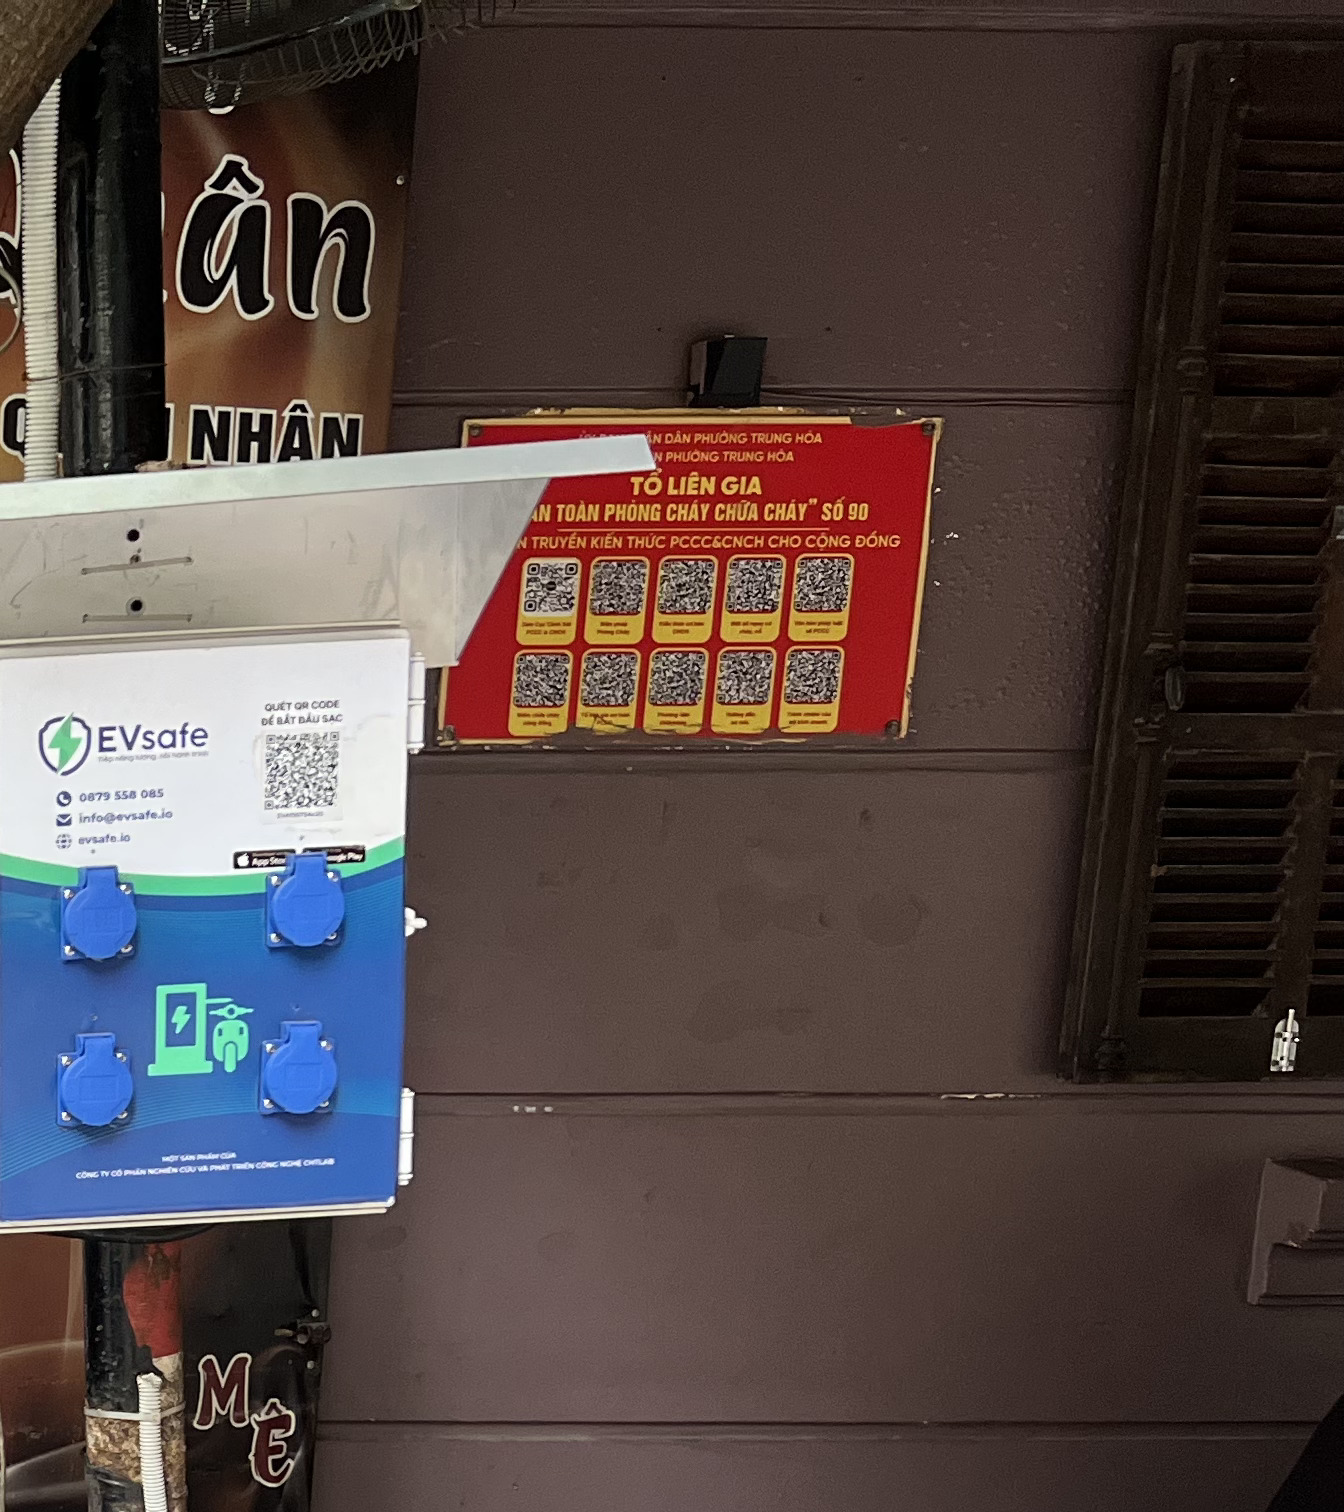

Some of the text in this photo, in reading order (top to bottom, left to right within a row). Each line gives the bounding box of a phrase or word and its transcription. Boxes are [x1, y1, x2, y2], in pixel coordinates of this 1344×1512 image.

[188, 398, 365, 465] NHÂN
[664, 430, 823, 445] DÂN PHƯỜNG TRUNG HÒA
[665, 448, 795, 463] PHƯỜNG TRUNG HÒA
[629, 467, 763, 496] TỔ LIÊN GIA
[556, 495, 870, 523] TOÀN PHÒNG CHÁY CHỮA SỐ 90
[532, 532, 587, 550] TRUYỀN
[590, 531, 623, 550] KIẾN
[627, 533, 666, 549] THỨC
[669, 534, 765, 550] PCCC&CNCH
[768, 534, 802, 549] CHO
[805, 532, 852, 551] CỘNG
[854, 530, 902, 549] ĐỒNG
[295, 701, 309, 711] QR
[311, 699, 341, 711] CODE
[98, 721, 210, 754] EVsafe
[79, 788, 164, 803] 0879 558 085
[78, 807, 174, 825] info@evsafe.io
[77, 832, 131, 846] evsafe.io
